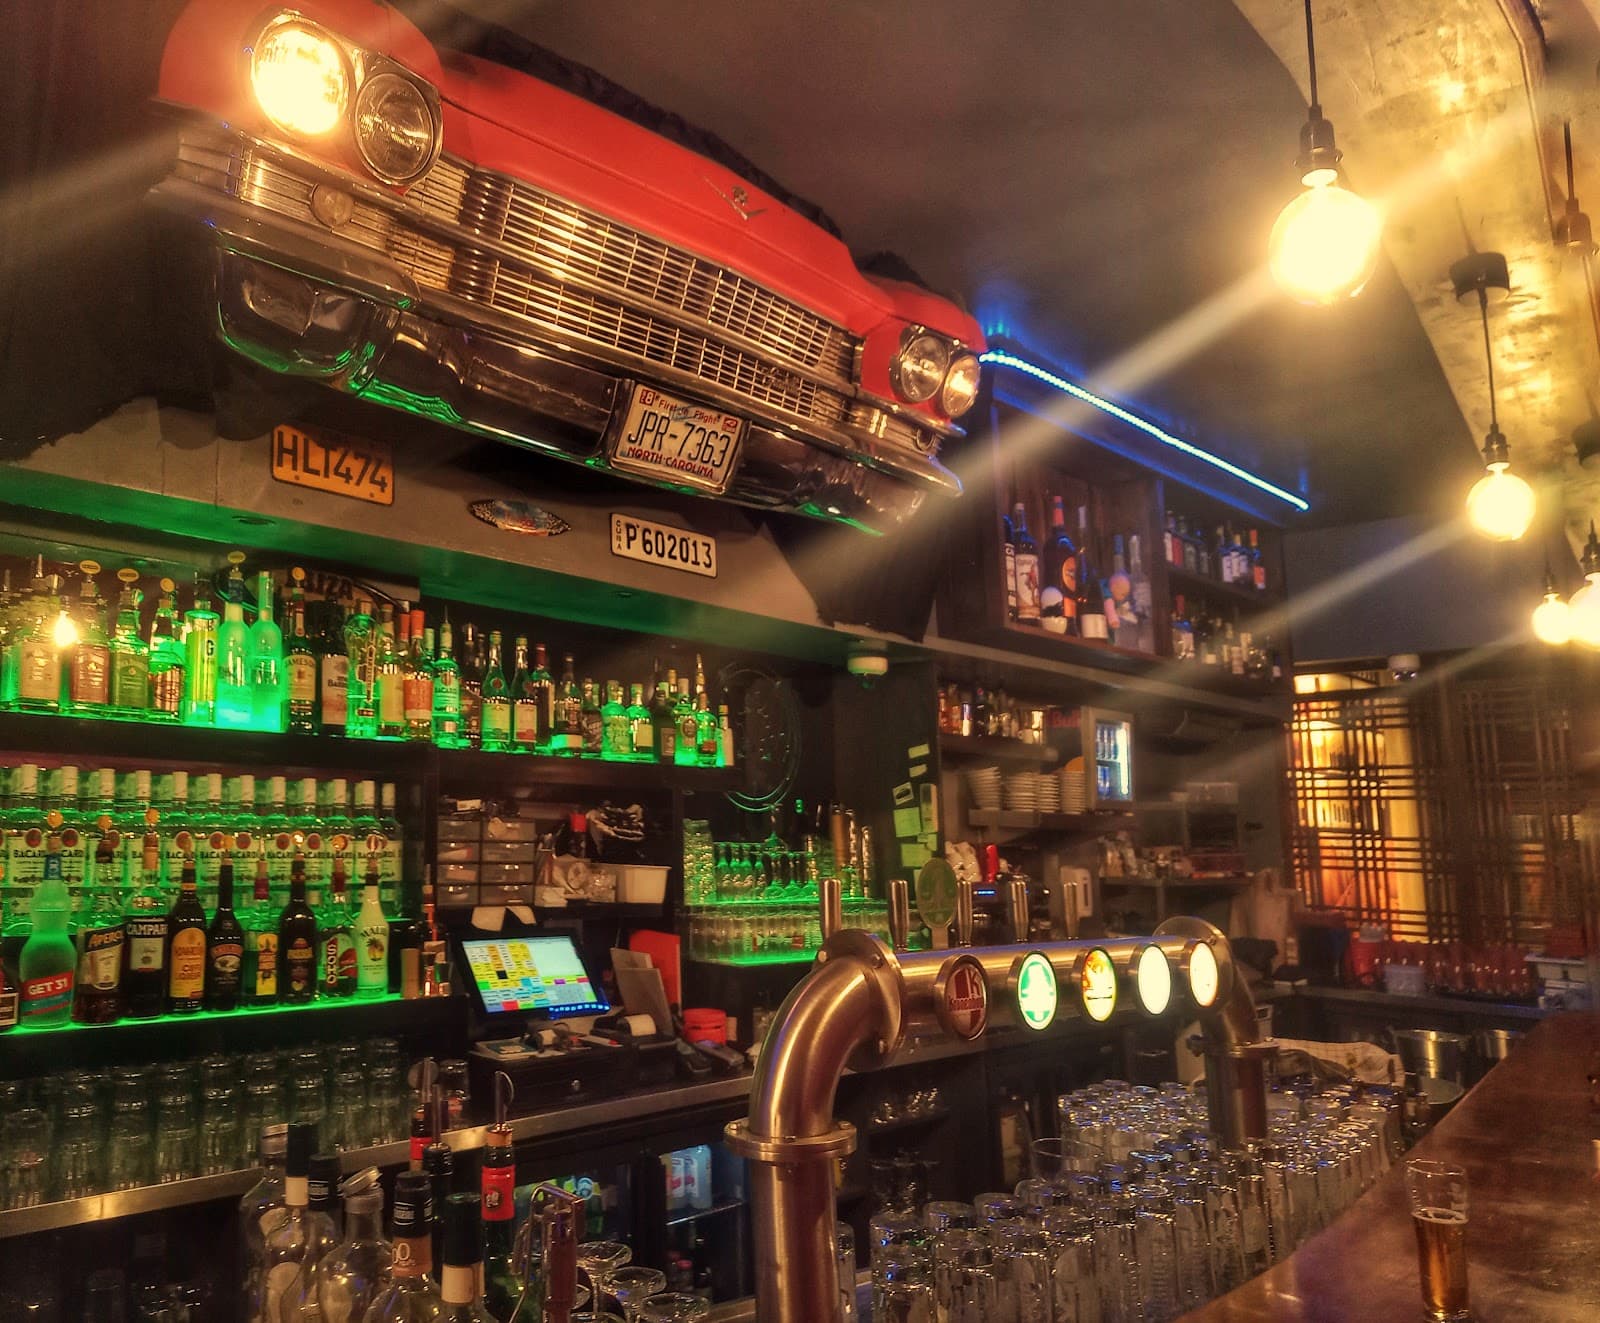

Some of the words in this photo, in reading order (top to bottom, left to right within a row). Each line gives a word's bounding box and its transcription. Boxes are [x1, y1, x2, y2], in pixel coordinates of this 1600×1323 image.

[659, 399, 677, 413] First
[694, 408, 719, 426] Flight
[627, 409, 731, 468] JPR-7363
[627, 446, 663, 465] NORTH
[665, 456, 714, 479] CAROLINA
[326, 943, 338, 985] SOHO
[28, 982, 53, 996] GET
[55, 978, 68, 991] 31
